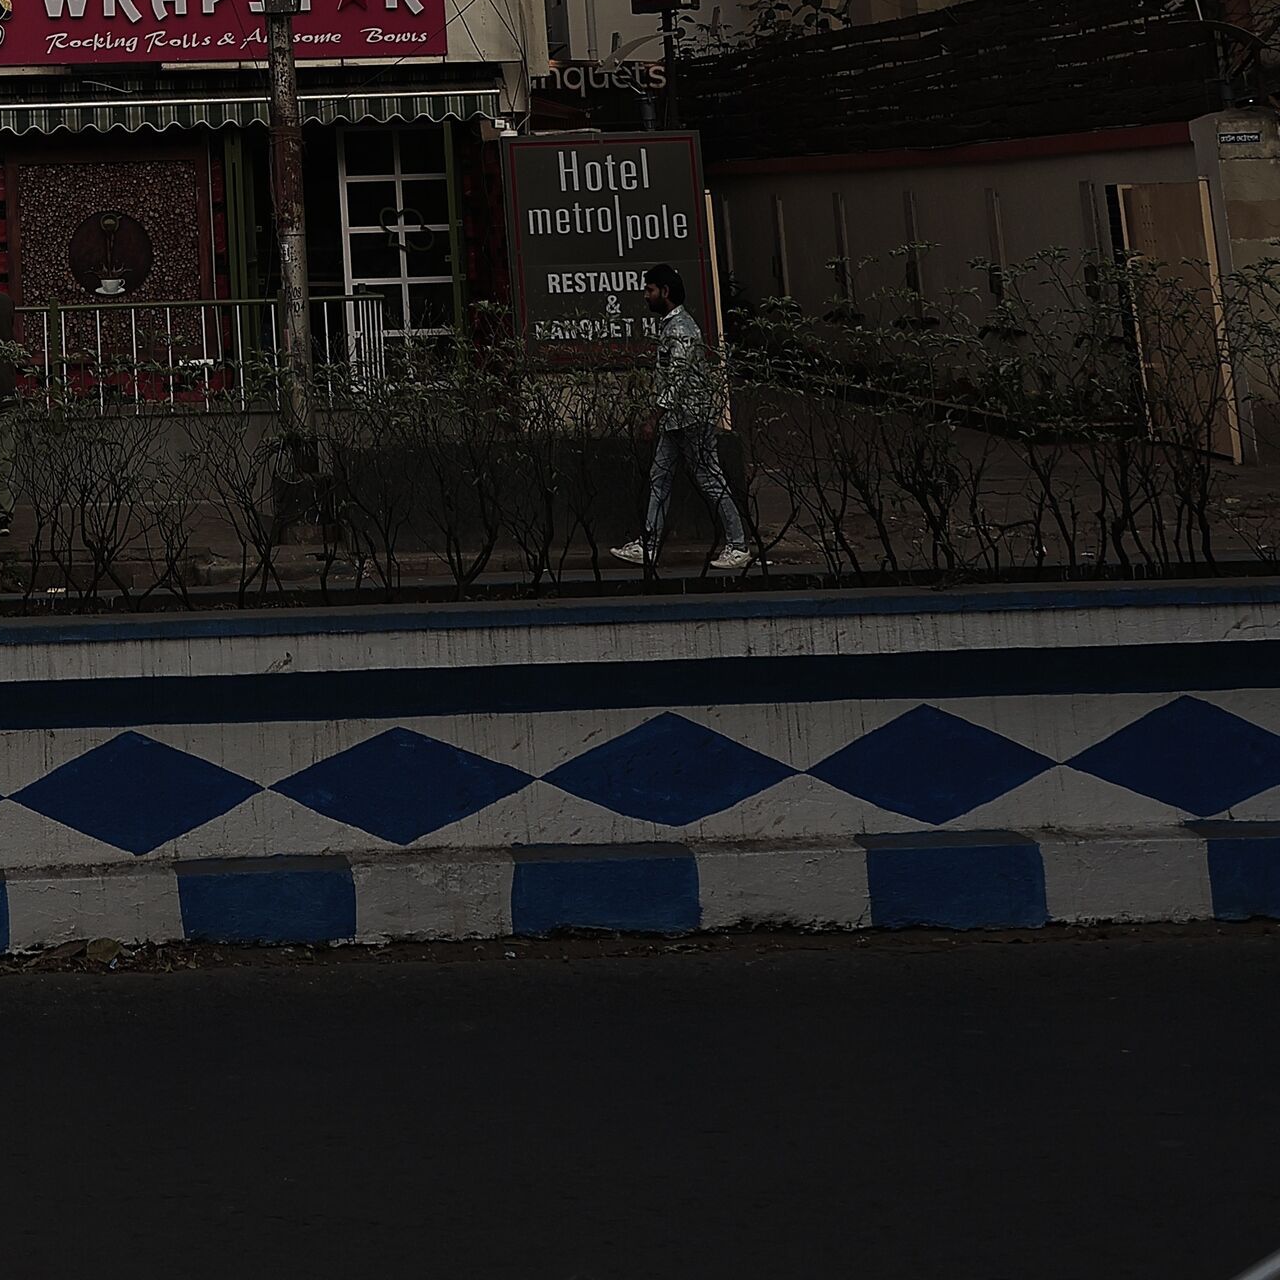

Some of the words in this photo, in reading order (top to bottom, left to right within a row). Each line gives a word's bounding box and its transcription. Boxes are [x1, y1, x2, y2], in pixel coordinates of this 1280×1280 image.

[46, 30, 138, 54] Rocking
[144, 29, 212, 51] Rolls
[217, 33, 236, 46] &
[557, 148, 650, 192] Hotel
[605, 295, 622, 314] &
